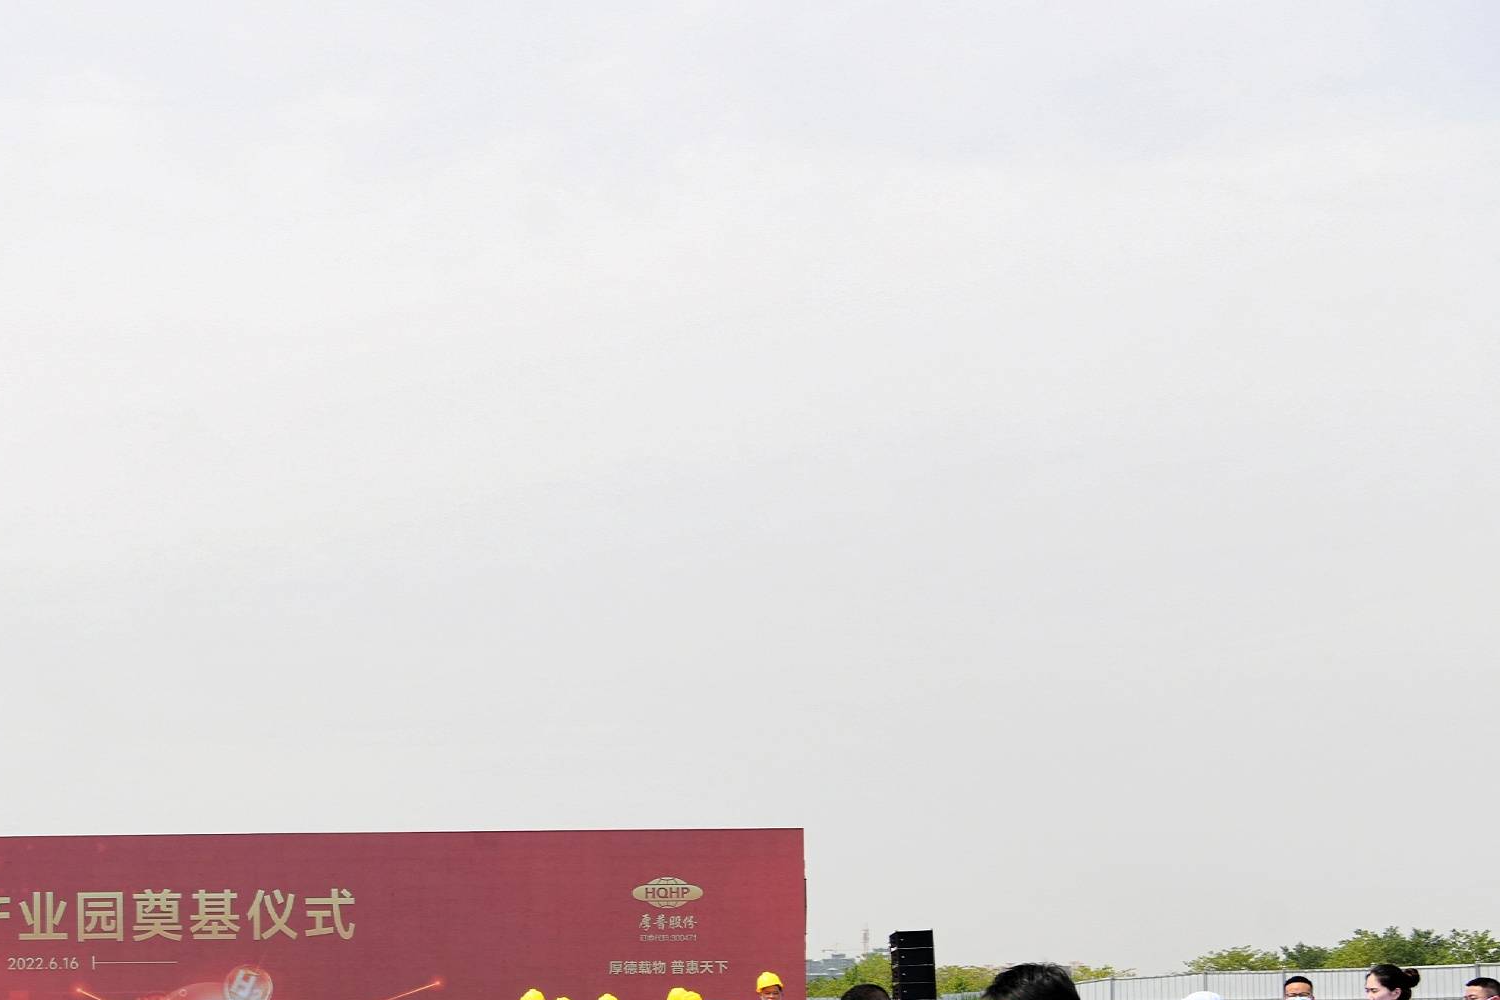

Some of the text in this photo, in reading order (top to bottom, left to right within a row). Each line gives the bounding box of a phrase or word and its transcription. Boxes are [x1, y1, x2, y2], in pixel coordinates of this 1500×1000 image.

[644, 886, 691, 899] HQHP
[7, 957, 80, 970] 2022.6.16
[608, 960, 729, 975] 厚德载物 普惠天下
